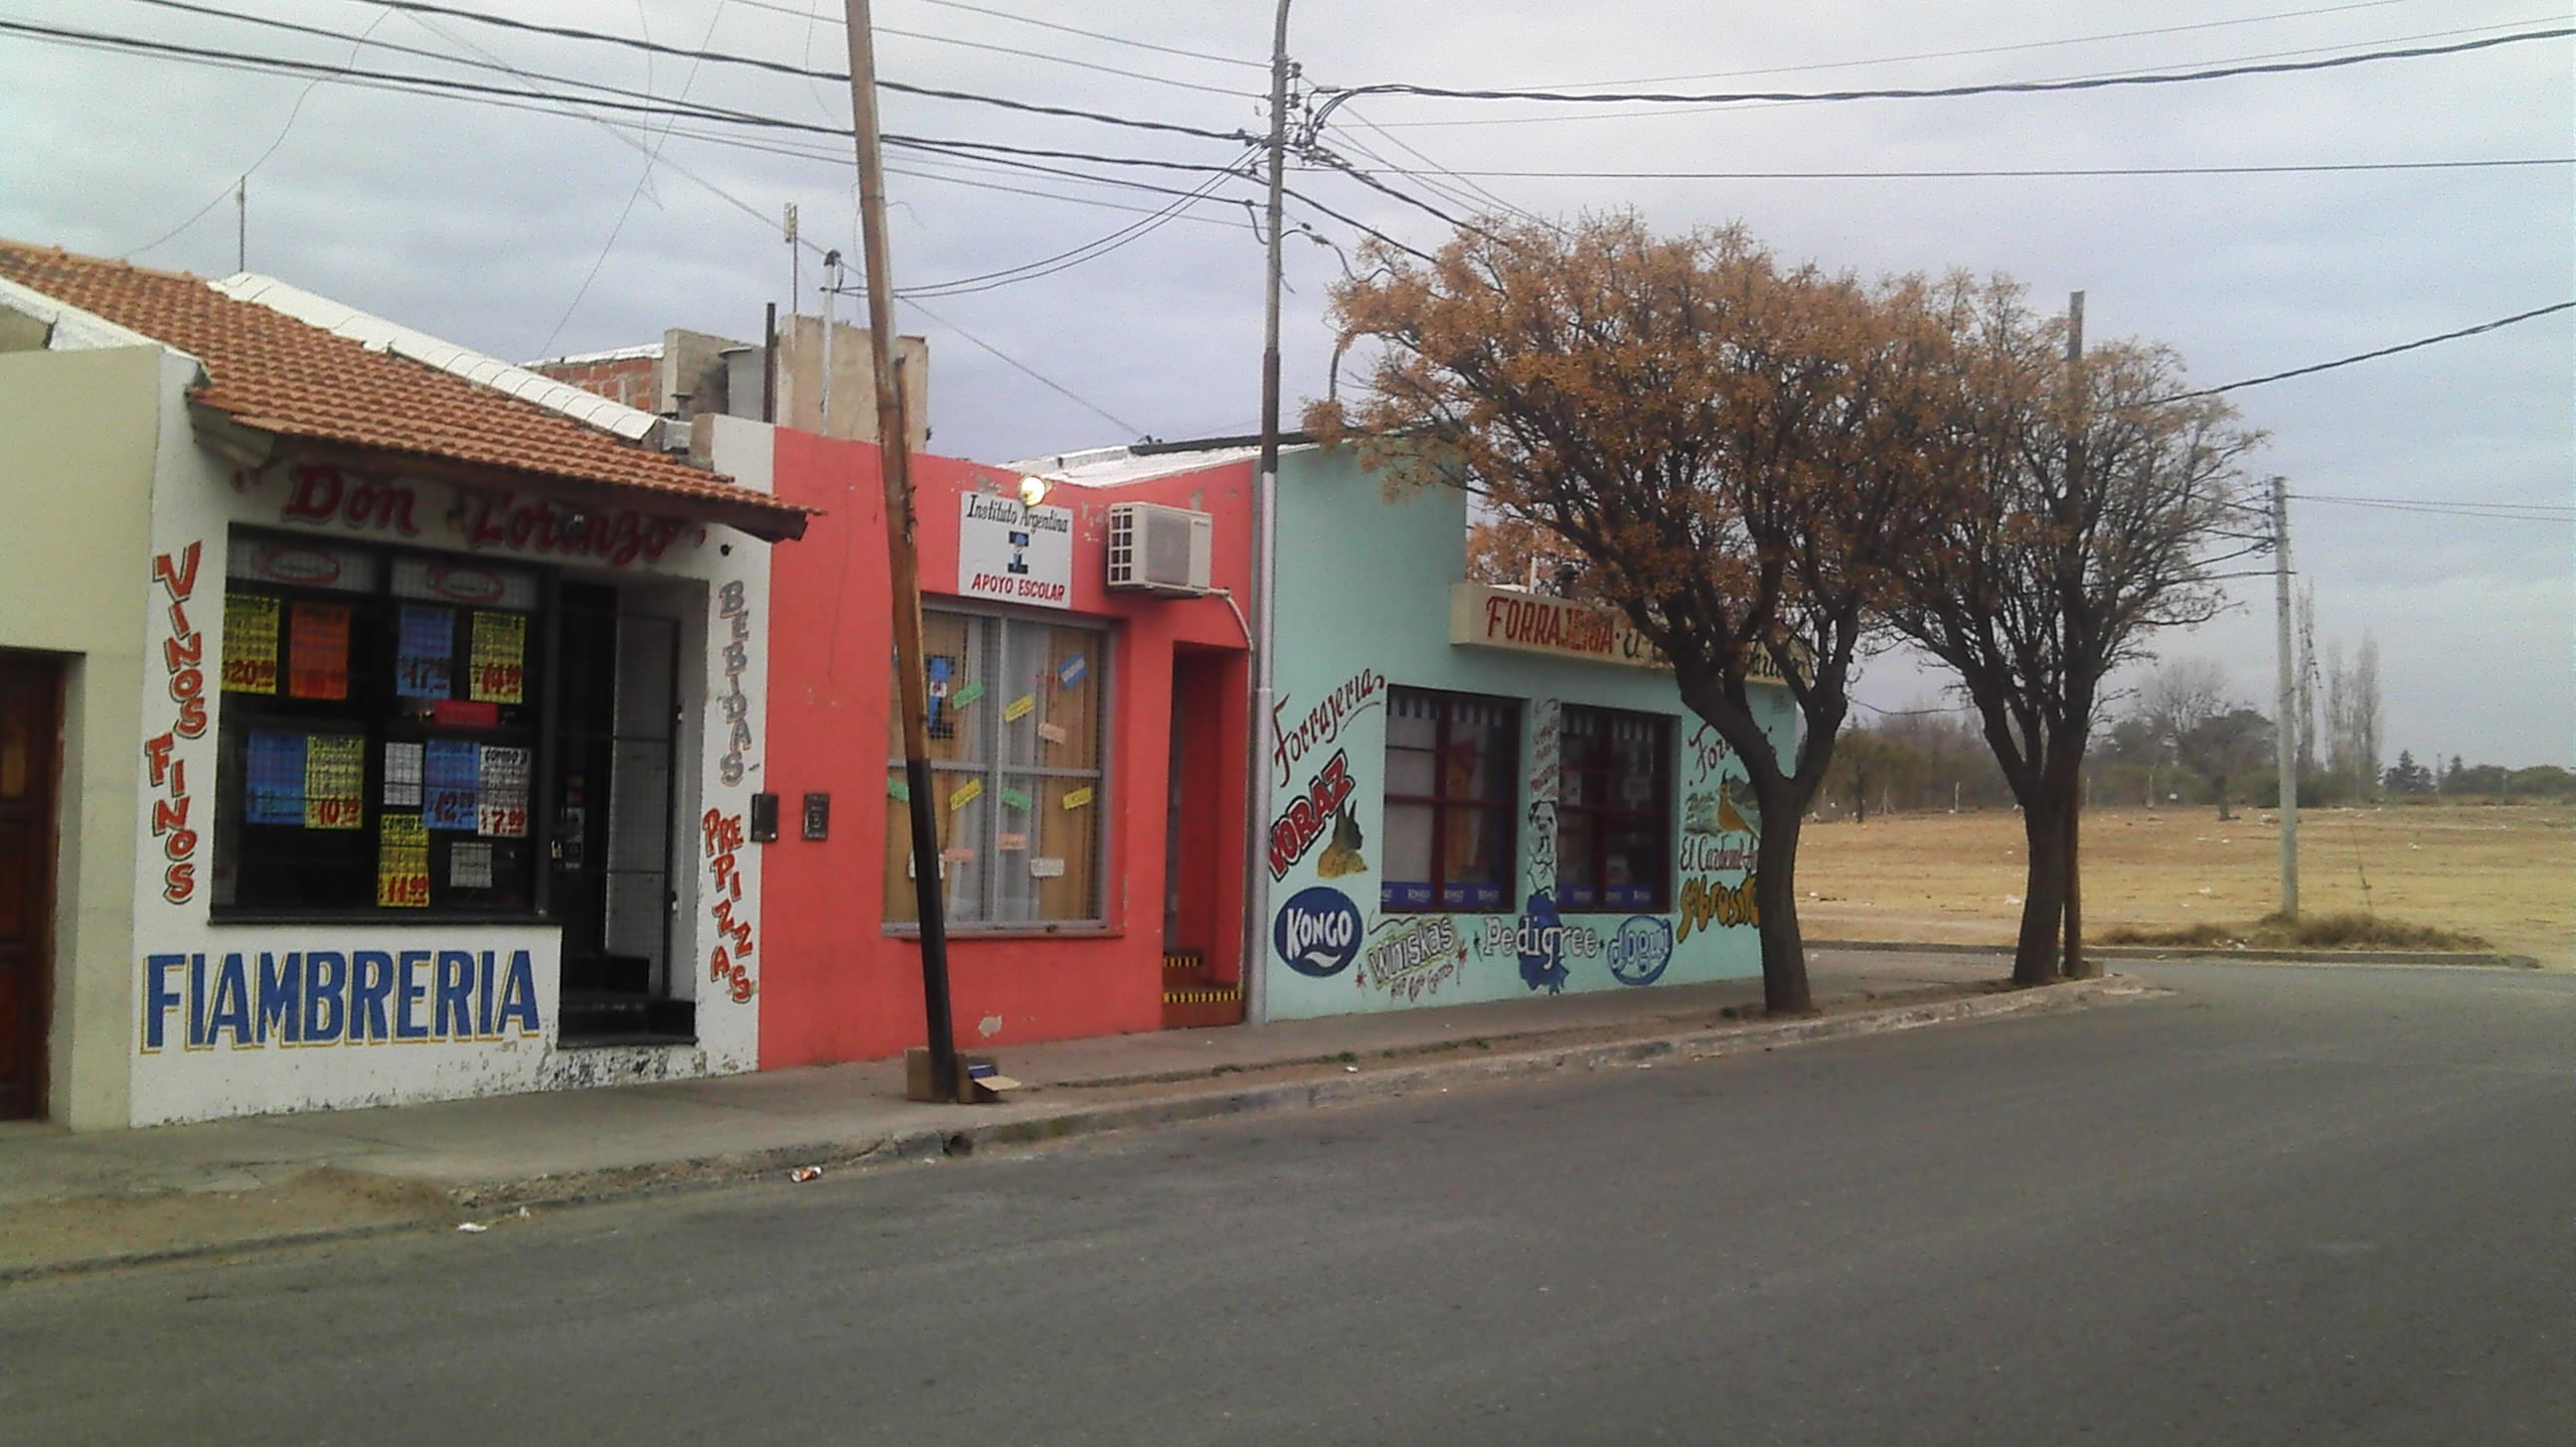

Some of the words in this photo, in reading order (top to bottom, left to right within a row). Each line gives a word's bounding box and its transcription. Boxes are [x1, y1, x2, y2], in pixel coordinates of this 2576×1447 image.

[967, 495, 1018, 525] Instituto
[1019, 508, 1069, 535] Argentina
[153, 540, 207, 738] VINOS
[971, 572, 1014, 594] APOYO
[1017, 579, 1065, 601] ESCOLAR
[718, 579, 753, 788] BEBIDAS
[1273, 667, 1385, 788] Forrajeria
[144, 733, 197, 905] FINOS
[1268, 747, 1357, 883] VORAZ
[1285, 906, 1354, 960] KONGO
[1483, 915, 1598, 971] Pedigree
[140, 947, 542, 1053] FIAMBRERIA
